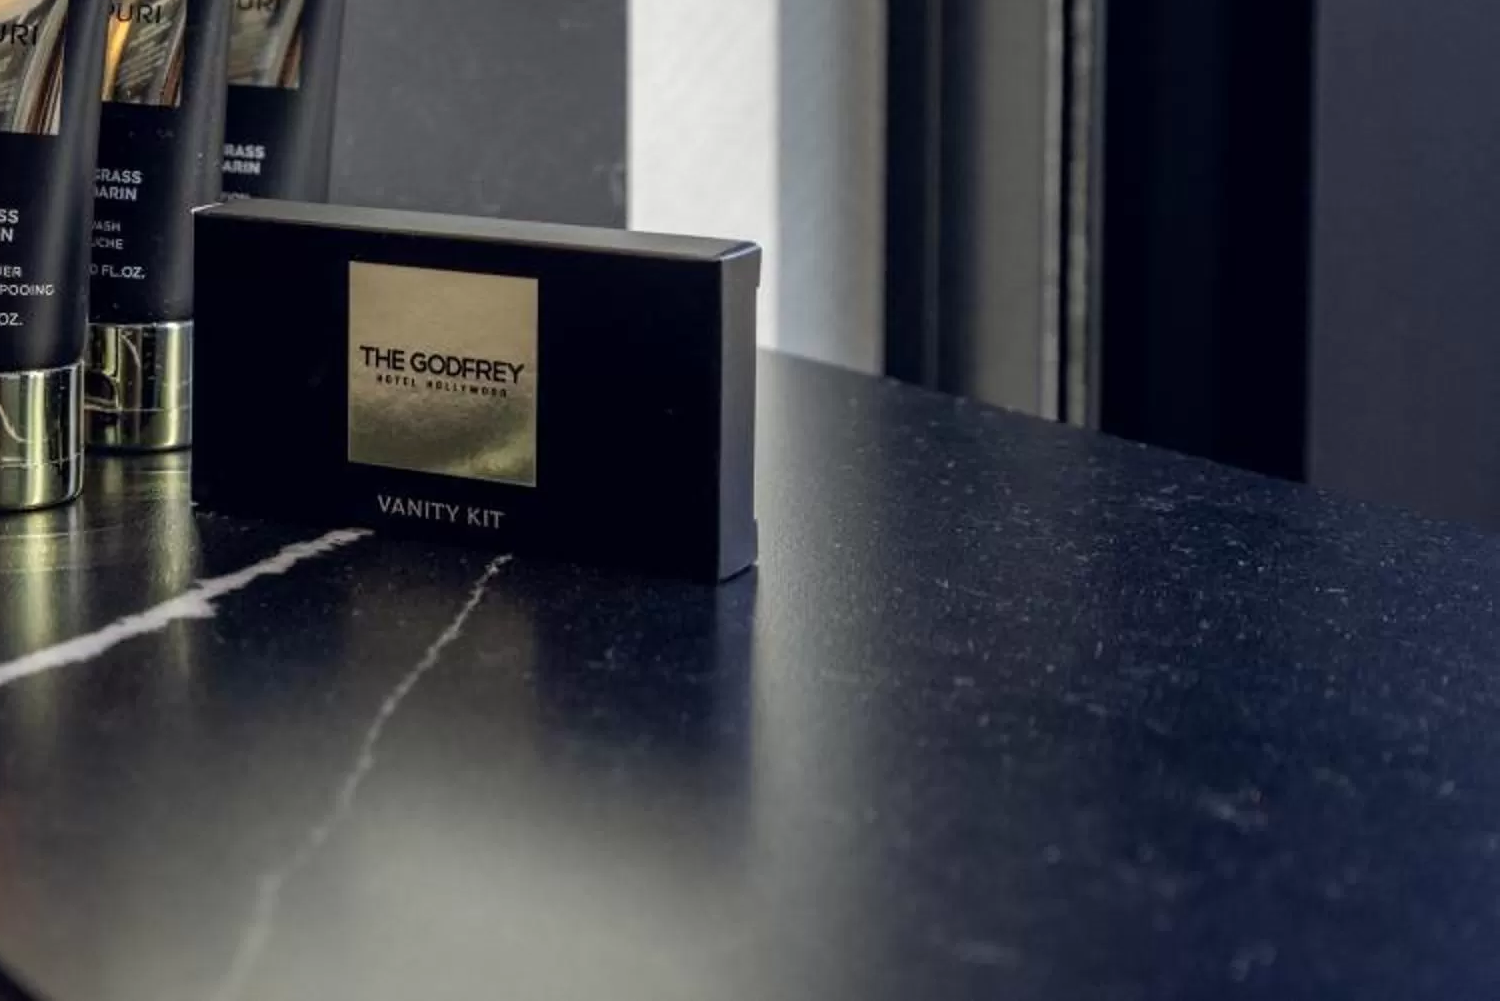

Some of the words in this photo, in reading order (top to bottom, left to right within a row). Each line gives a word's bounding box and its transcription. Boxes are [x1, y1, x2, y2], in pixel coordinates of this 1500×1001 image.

[94, 186, 137, 202] ARIN
[359, 344, 405, 371] THE
[410, 351, 525, 385] GODFREY
[376, 374, 416, 388] HOTEL
[426, 380, 507, 398] HOLLYWOOD
[377, 494, 460, 523] VANITY
[467, 507, 506, 529] KIT
